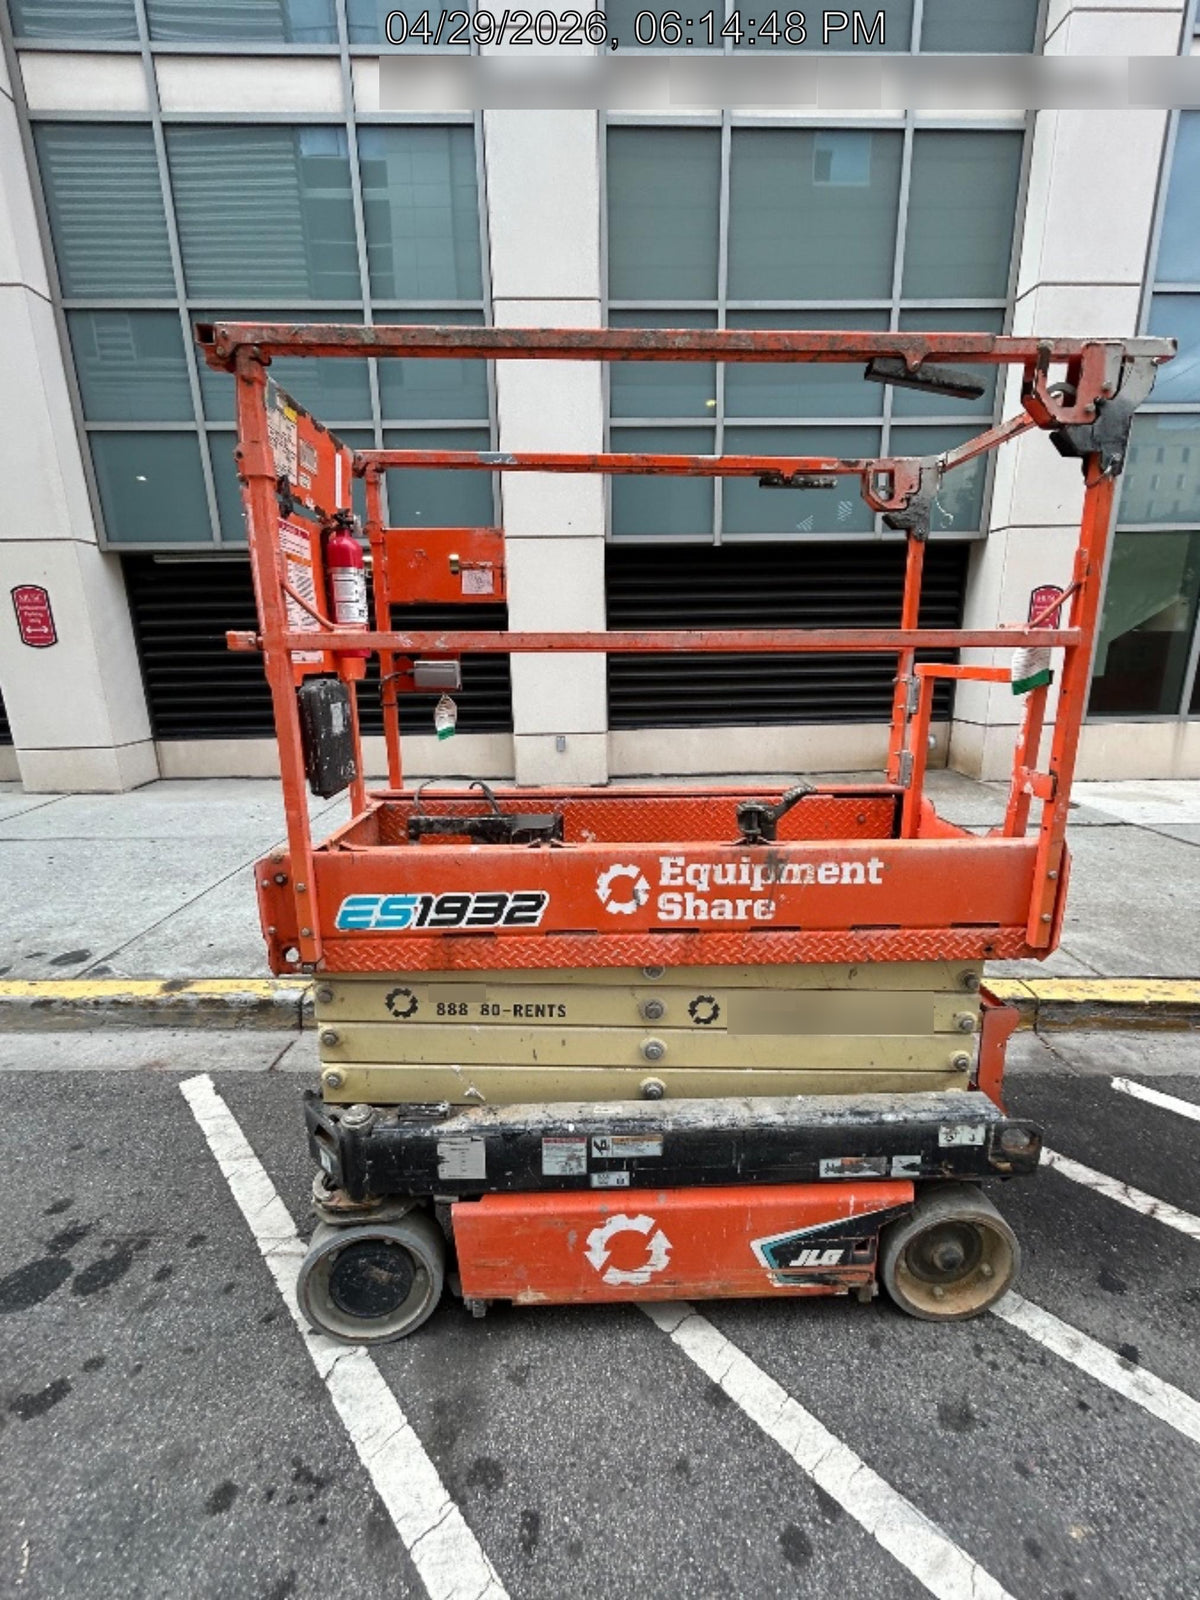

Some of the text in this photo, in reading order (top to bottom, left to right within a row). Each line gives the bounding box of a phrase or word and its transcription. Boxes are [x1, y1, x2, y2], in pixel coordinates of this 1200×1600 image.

[659, 856, 884, 891] Equipment
[335, 890, 549, 932] ES1932
[657, 892, 776, 921] Share
[436, 1002, 567, 1018] 888 80-RENTS
[788, 1249, 845, 1267] JLG
